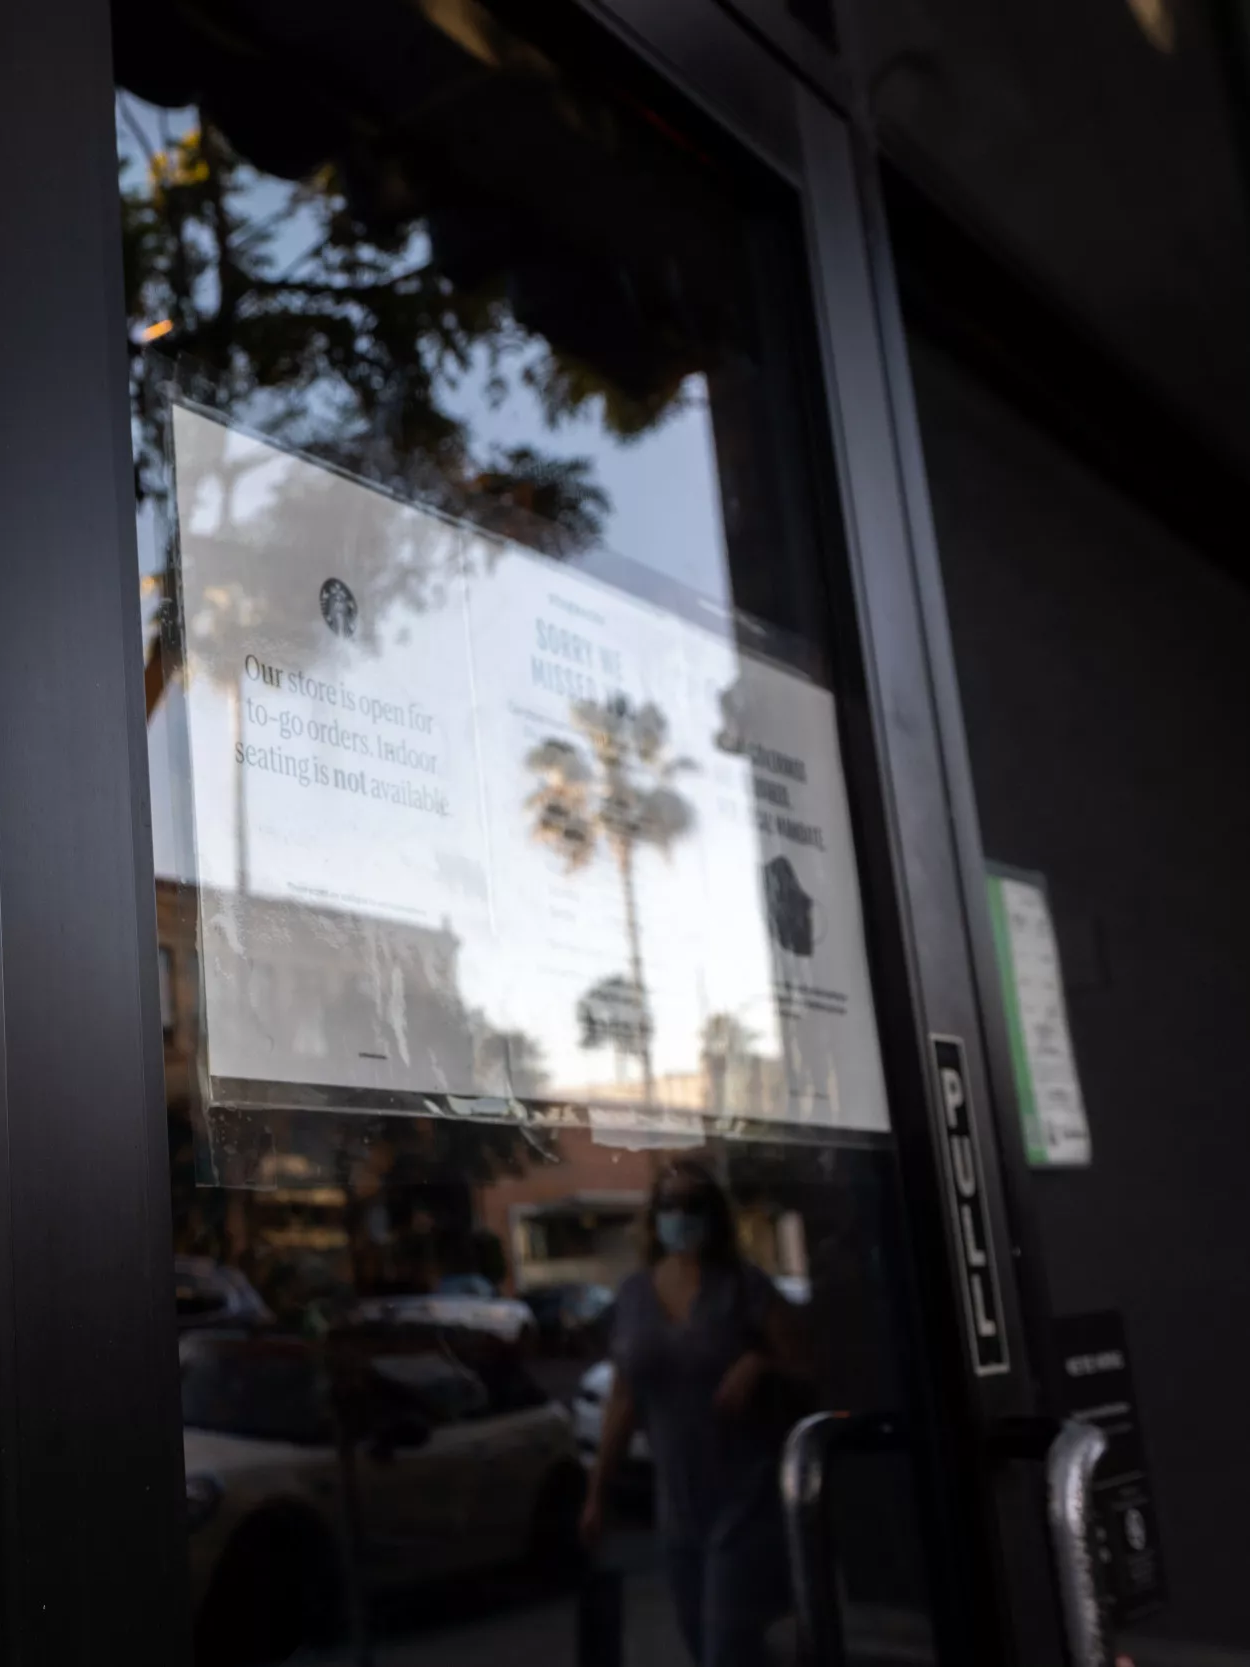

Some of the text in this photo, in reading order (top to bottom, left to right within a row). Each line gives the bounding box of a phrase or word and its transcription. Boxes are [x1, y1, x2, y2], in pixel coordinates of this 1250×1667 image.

[245, 654, 434, 735] Our store is open for
[235, 741, 311, 787] seating
[313, 756, 330, 786] is
[333, 768, 367, 796] not
[247, 697, 438, 775] to-go orders. Indoor
[940, 1066, 997, 1337] PULL
